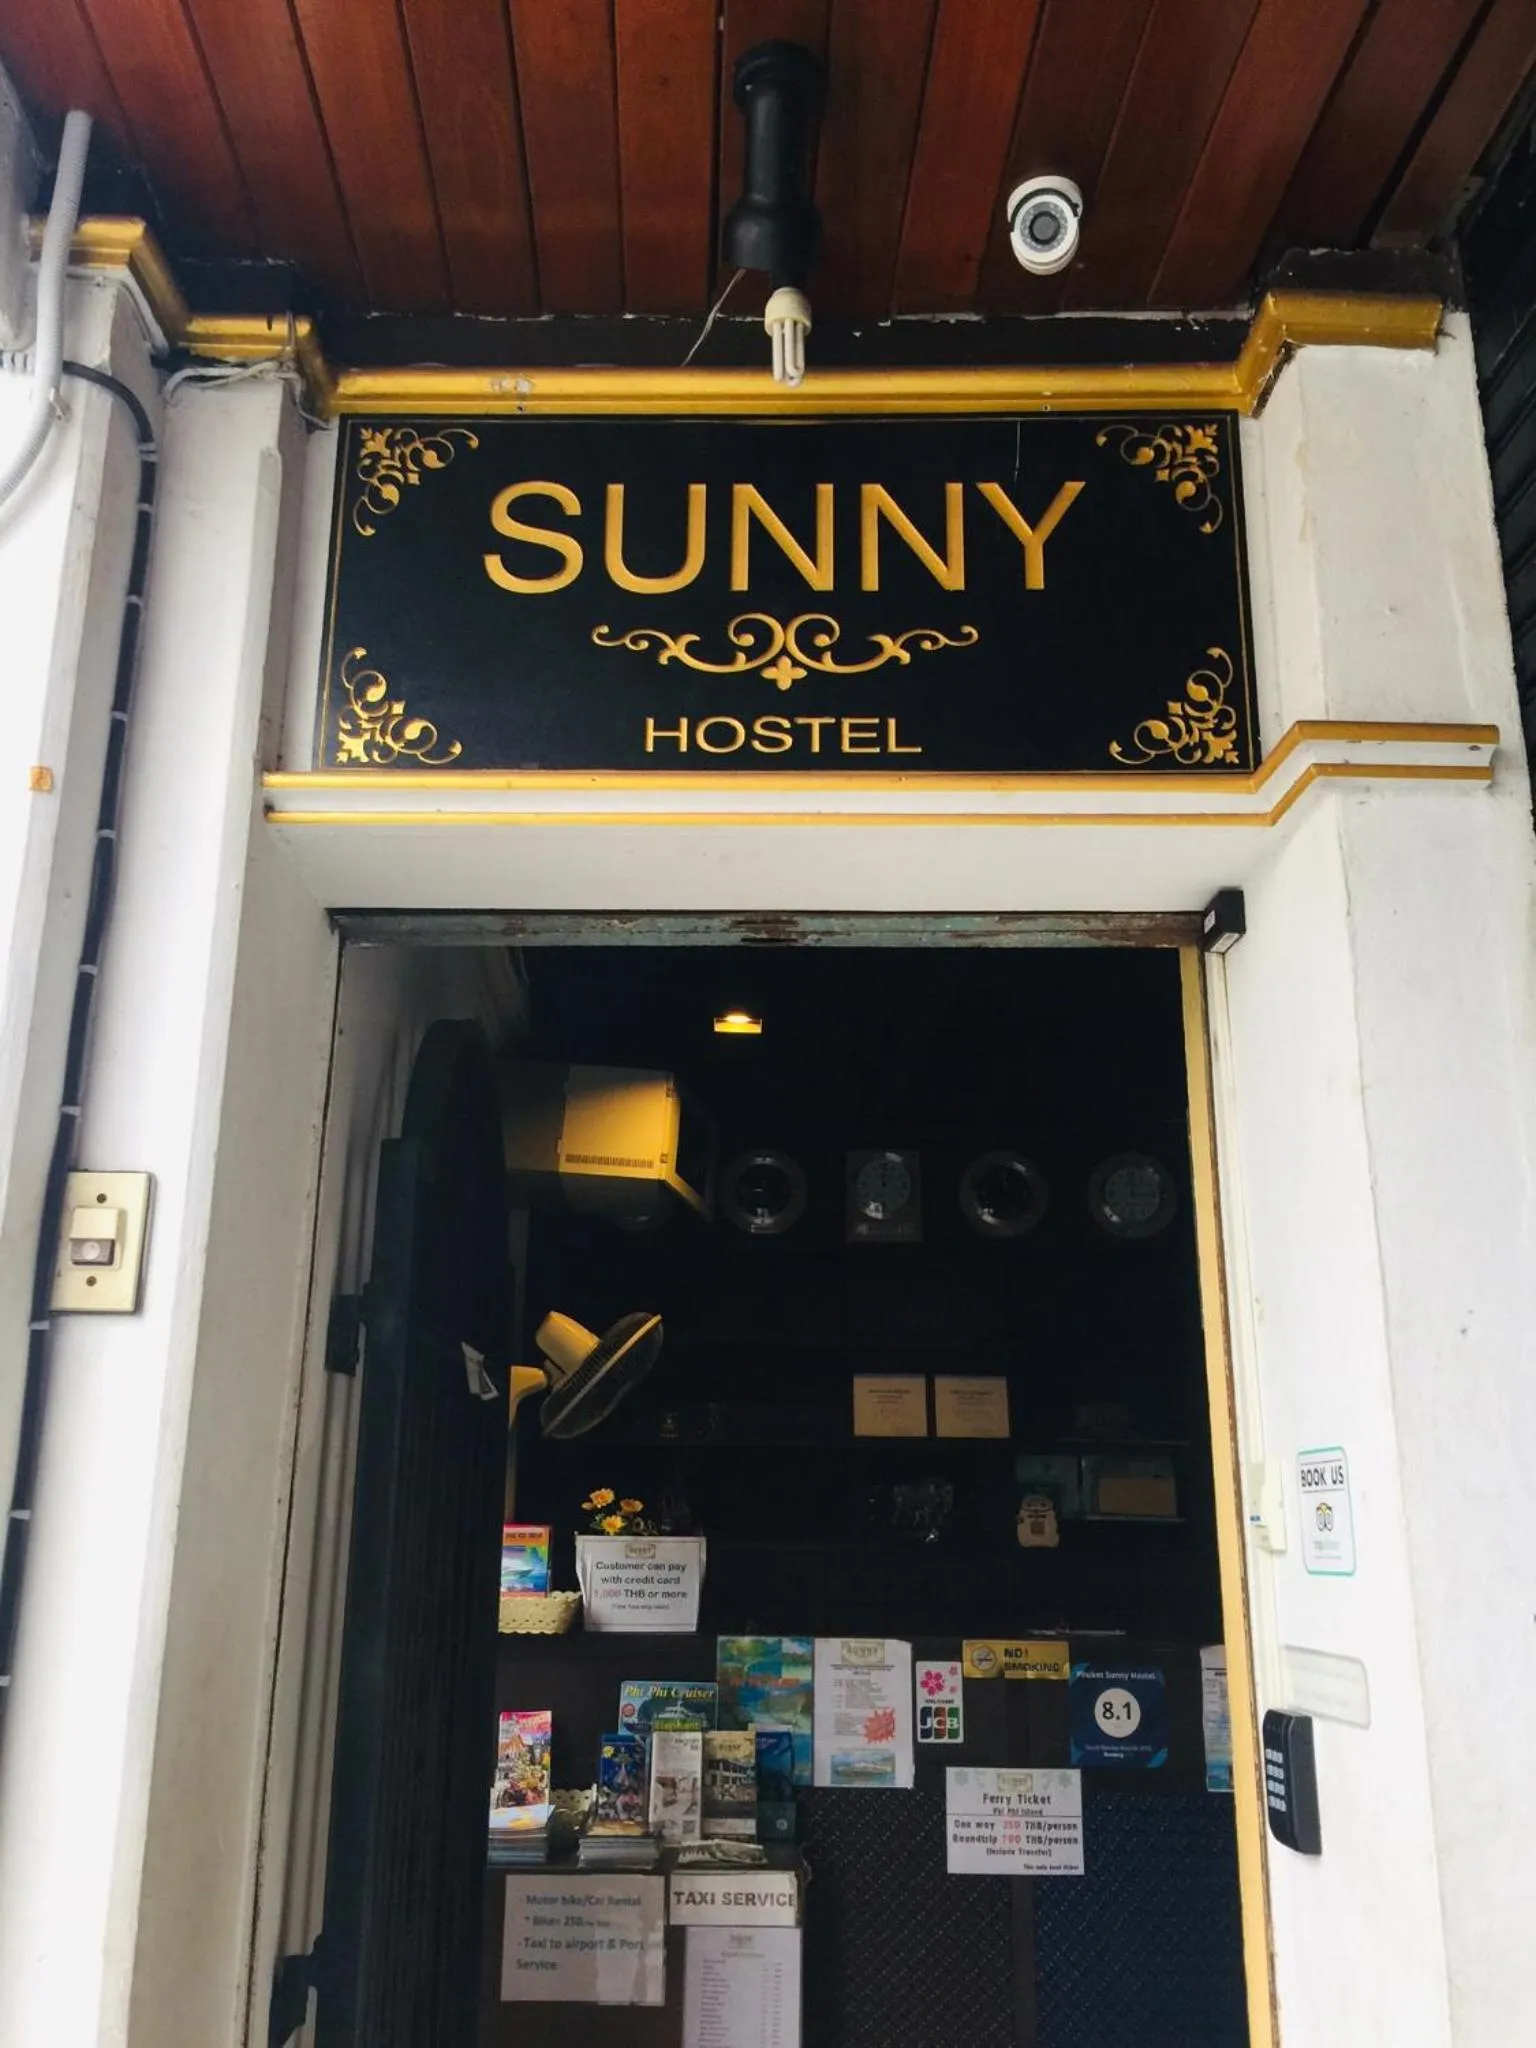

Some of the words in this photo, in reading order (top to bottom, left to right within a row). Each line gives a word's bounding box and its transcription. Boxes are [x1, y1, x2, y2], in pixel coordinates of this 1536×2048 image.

[483, 481, 1086, 595] SUNNY
[644, 716, 922, 755] HOSTEL
[1300, 1467, 1327, 1488] BOOK
[1330, 1464, 1345, 1485] US
[596, 1561, 645, 1571] Customer
[646, 1562, 666, 1571] can
[668, 1562, 687, 1573] pay
[601, 1575, 622, 1585] with
[624, 1575, 655, 1585] credit
[656, 1575, 681, 1585] card
[623, 1588, 646, 1599] THB
[647, 1590, 660, 1599] or
[661, 1591, 688, 1599] more
[1102, 1701, 1132, 1721] 8.1
[919, 1717, 960, 1730] JCB
[982, 1793, 1012, 1805] Ferry
[1016, 1793, 1052, 1805] Ticket
[975, 1821, 996, 1830] way
[673, 1891, 716, 1906] TAXI
[721, 1892, 796, 1908] SERVICE
[549, 1937, 563, 1950] to
[564, 1936, 605, 1952] airport
[515, 1957, 559, 1971] Service
